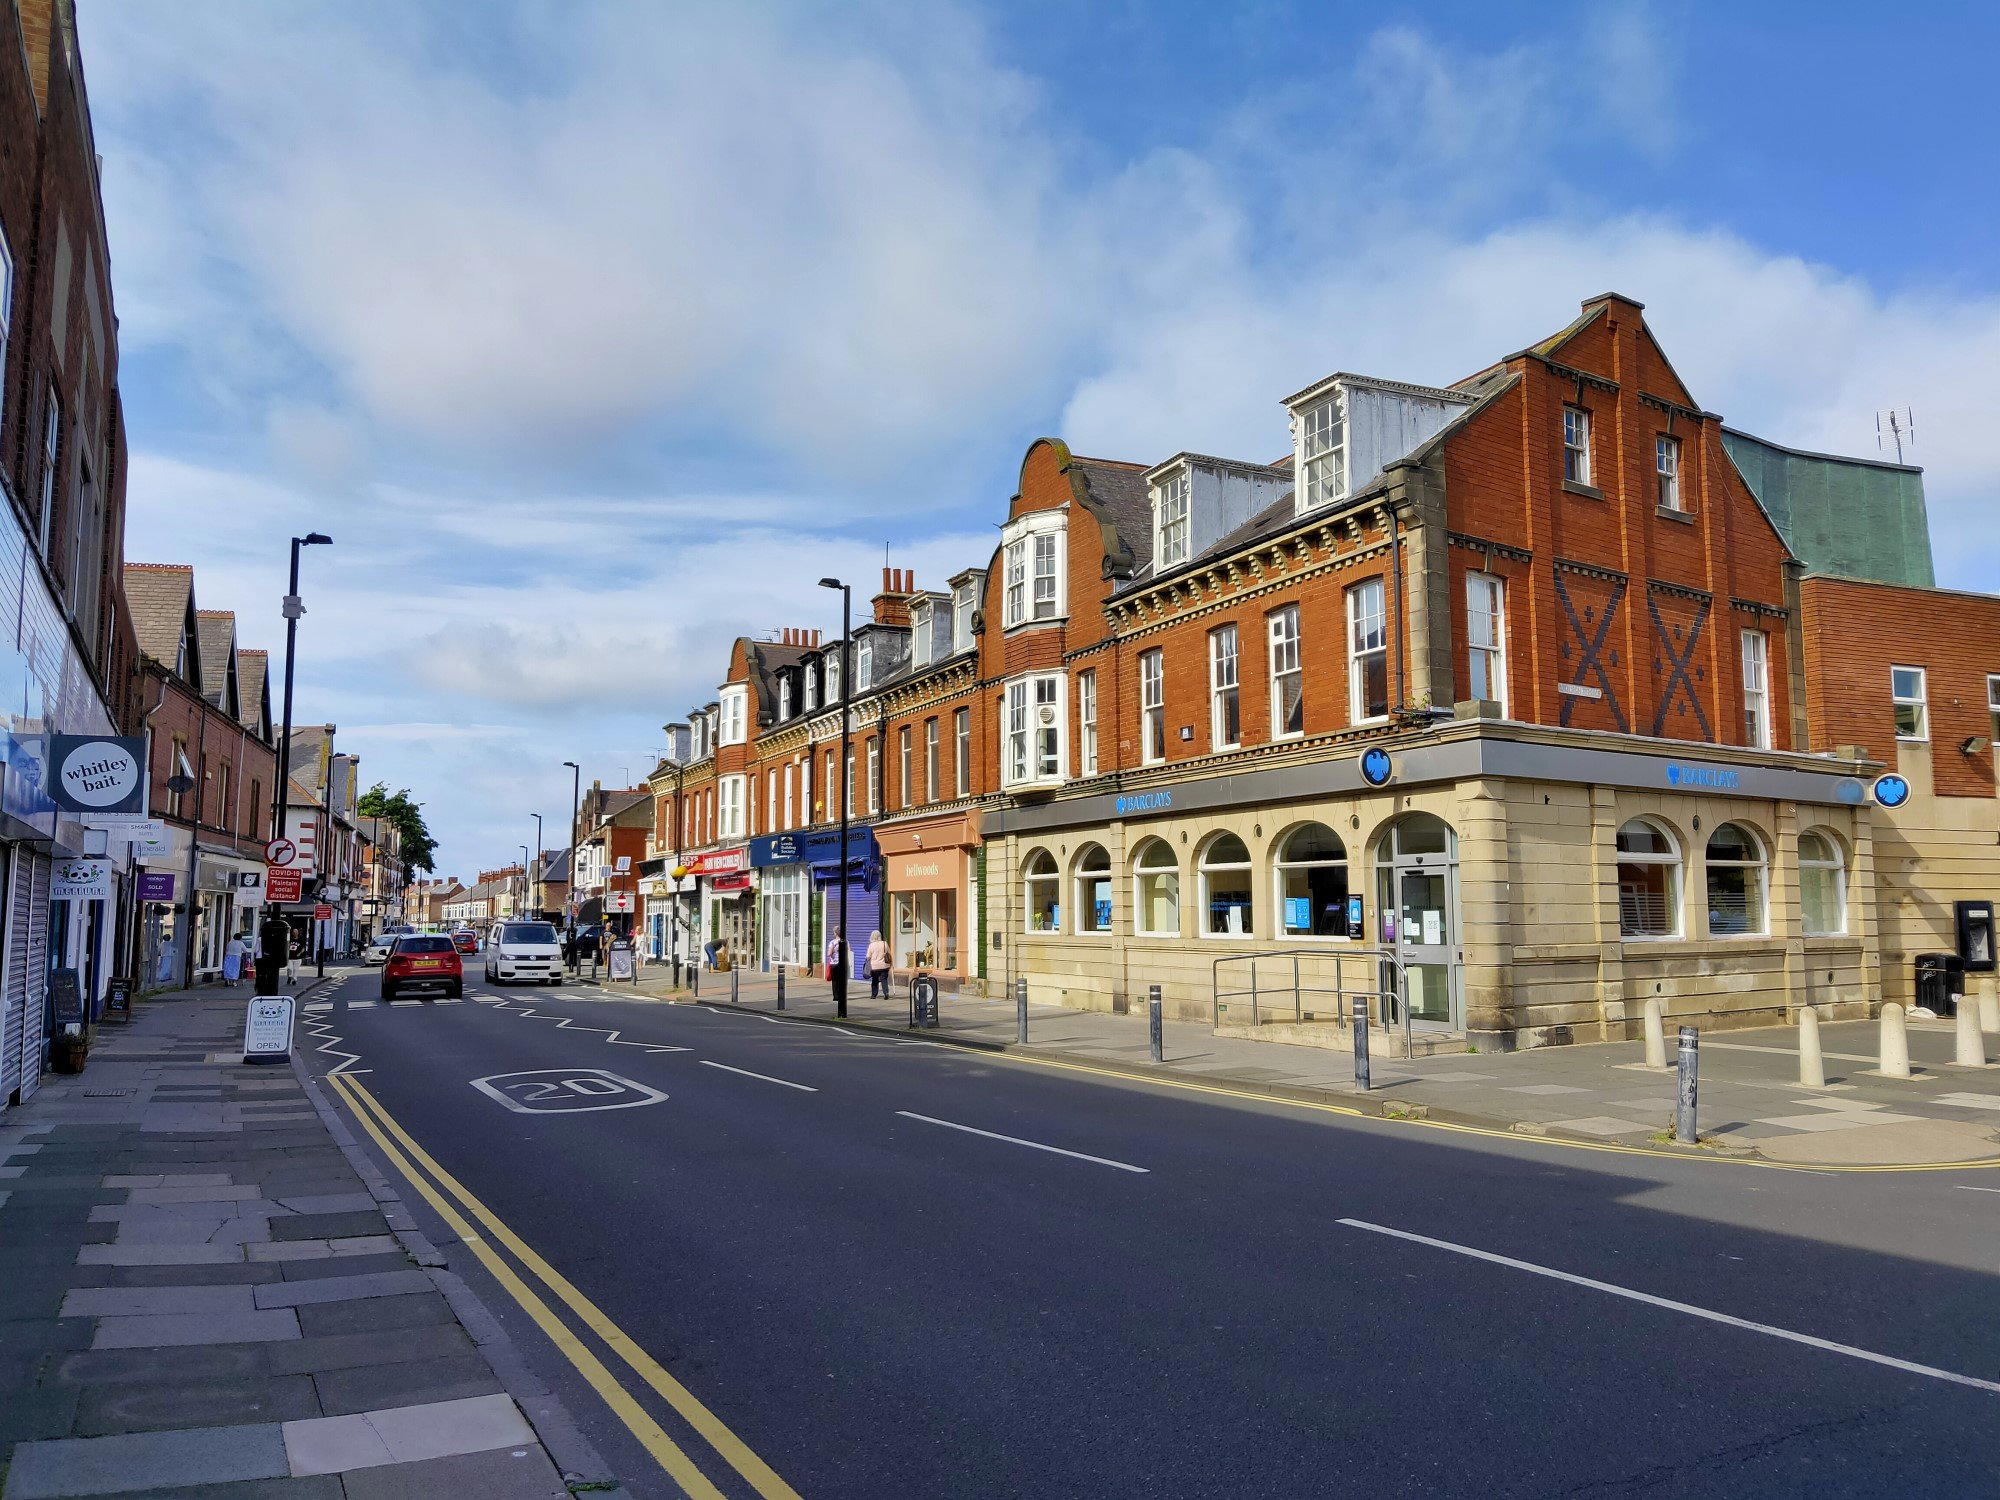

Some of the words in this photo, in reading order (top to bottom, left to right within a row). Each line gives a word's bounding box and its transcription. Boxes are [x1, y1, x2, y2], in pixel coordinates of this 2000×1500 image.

[66, 758, 128, 780] whitley
[1682, 767, 1739, 788] BARCLAYS
[82, 775, 121, 793] bait.
[1127, 791, 1172, 812] BARCLAYS
[270, 869, 301, 877] COVID-19
[906, 862, 939, 877] bellwoods
[271, 879, 298, 887] Maintain
[505, 1078, 626, 1100] 20
